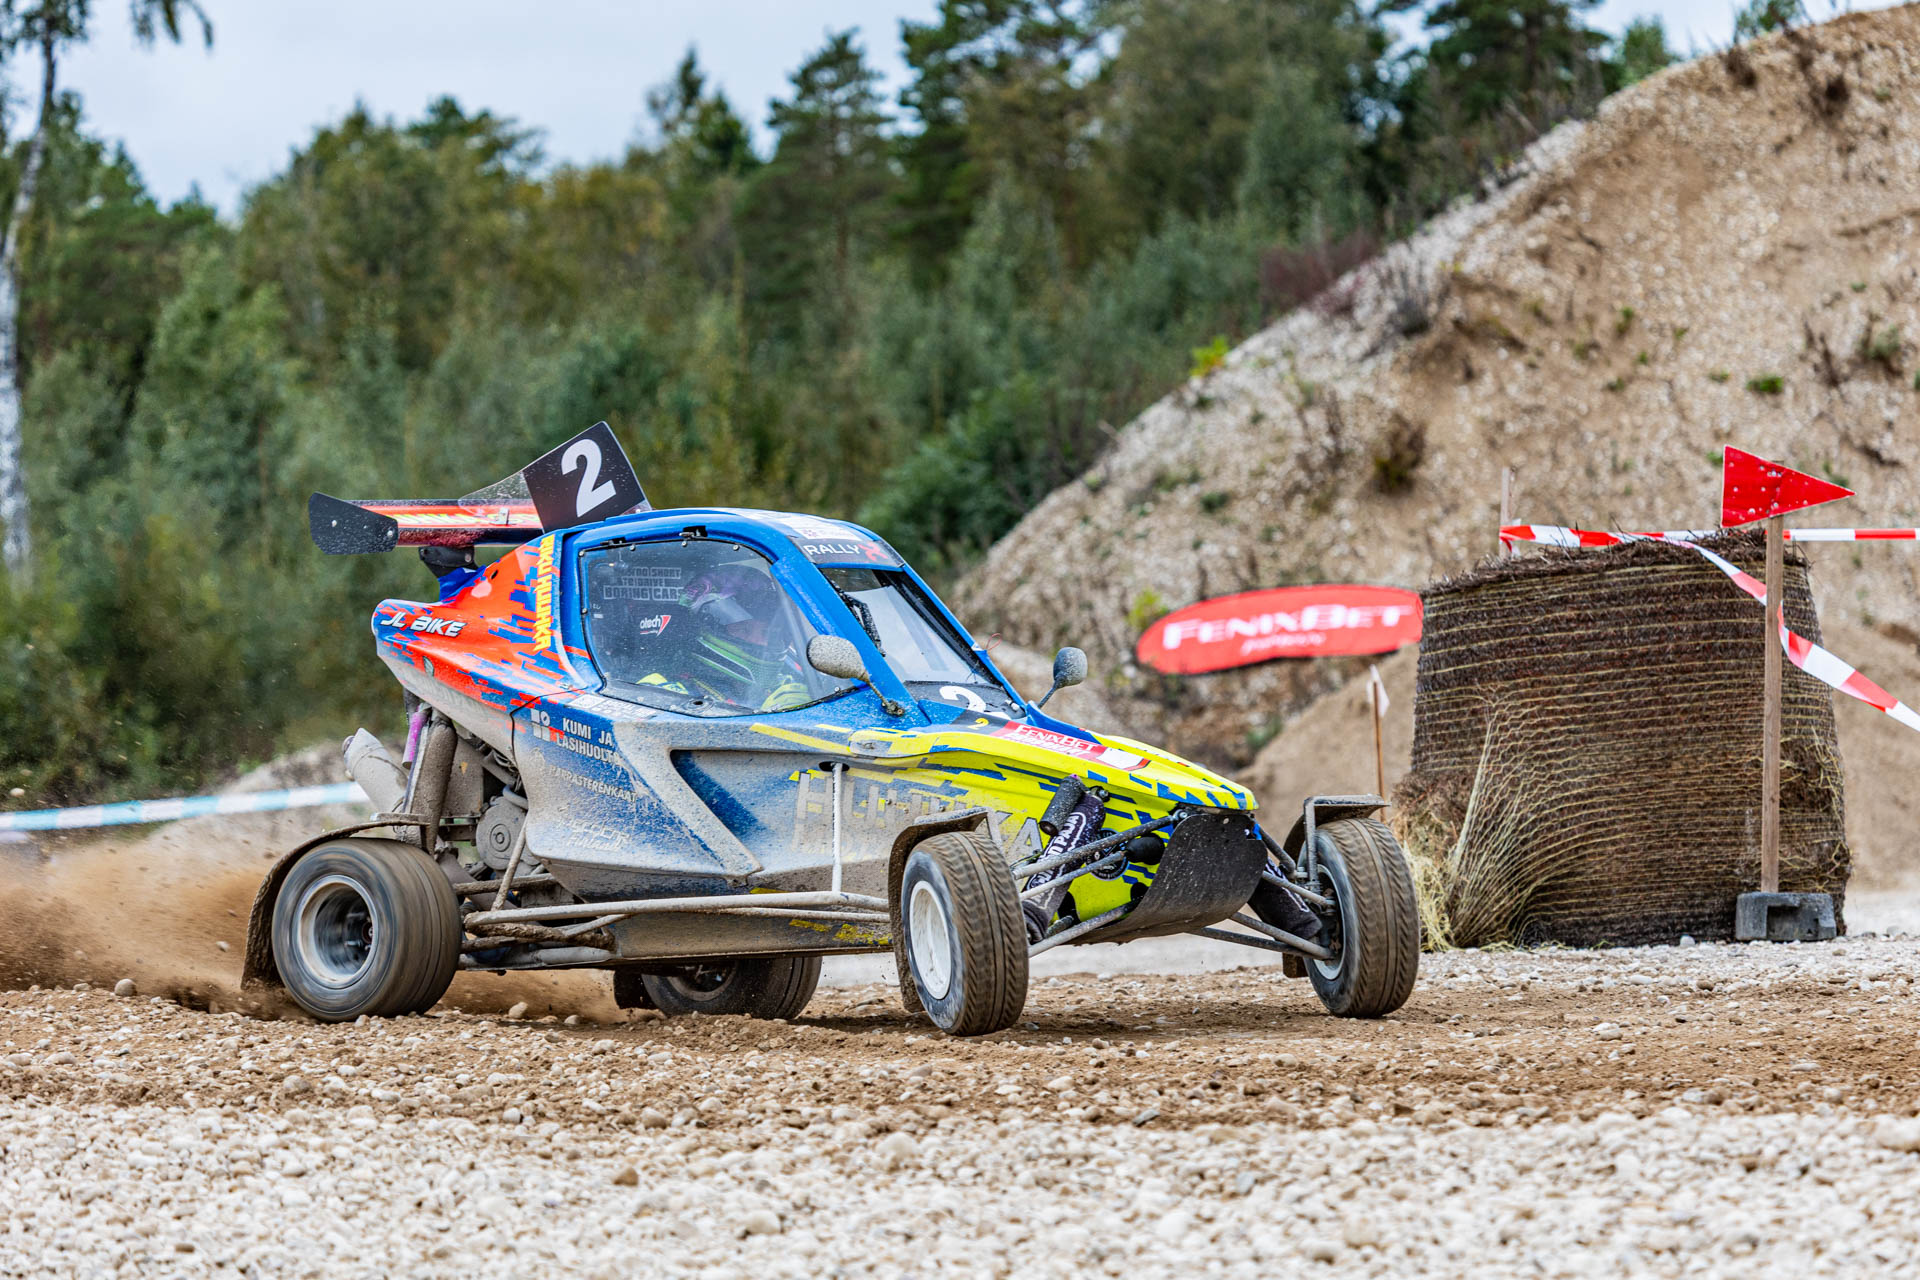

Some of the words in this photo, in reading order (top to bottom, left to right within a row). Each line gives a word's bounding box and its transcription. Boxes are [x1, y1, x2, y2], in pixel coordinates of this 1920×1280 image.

[561, 438, 617, 518] 2
[603, 585, 650, 600] BORING
[380, 611, 407, 629] JL
[410, 615, 468, 638] BIKE
[939, 685, 1011, 721] 2
[563, 717, 592, 740] KUMI
[598, 730, 613, 747] JA
[967, 717, 990, 730] 2
